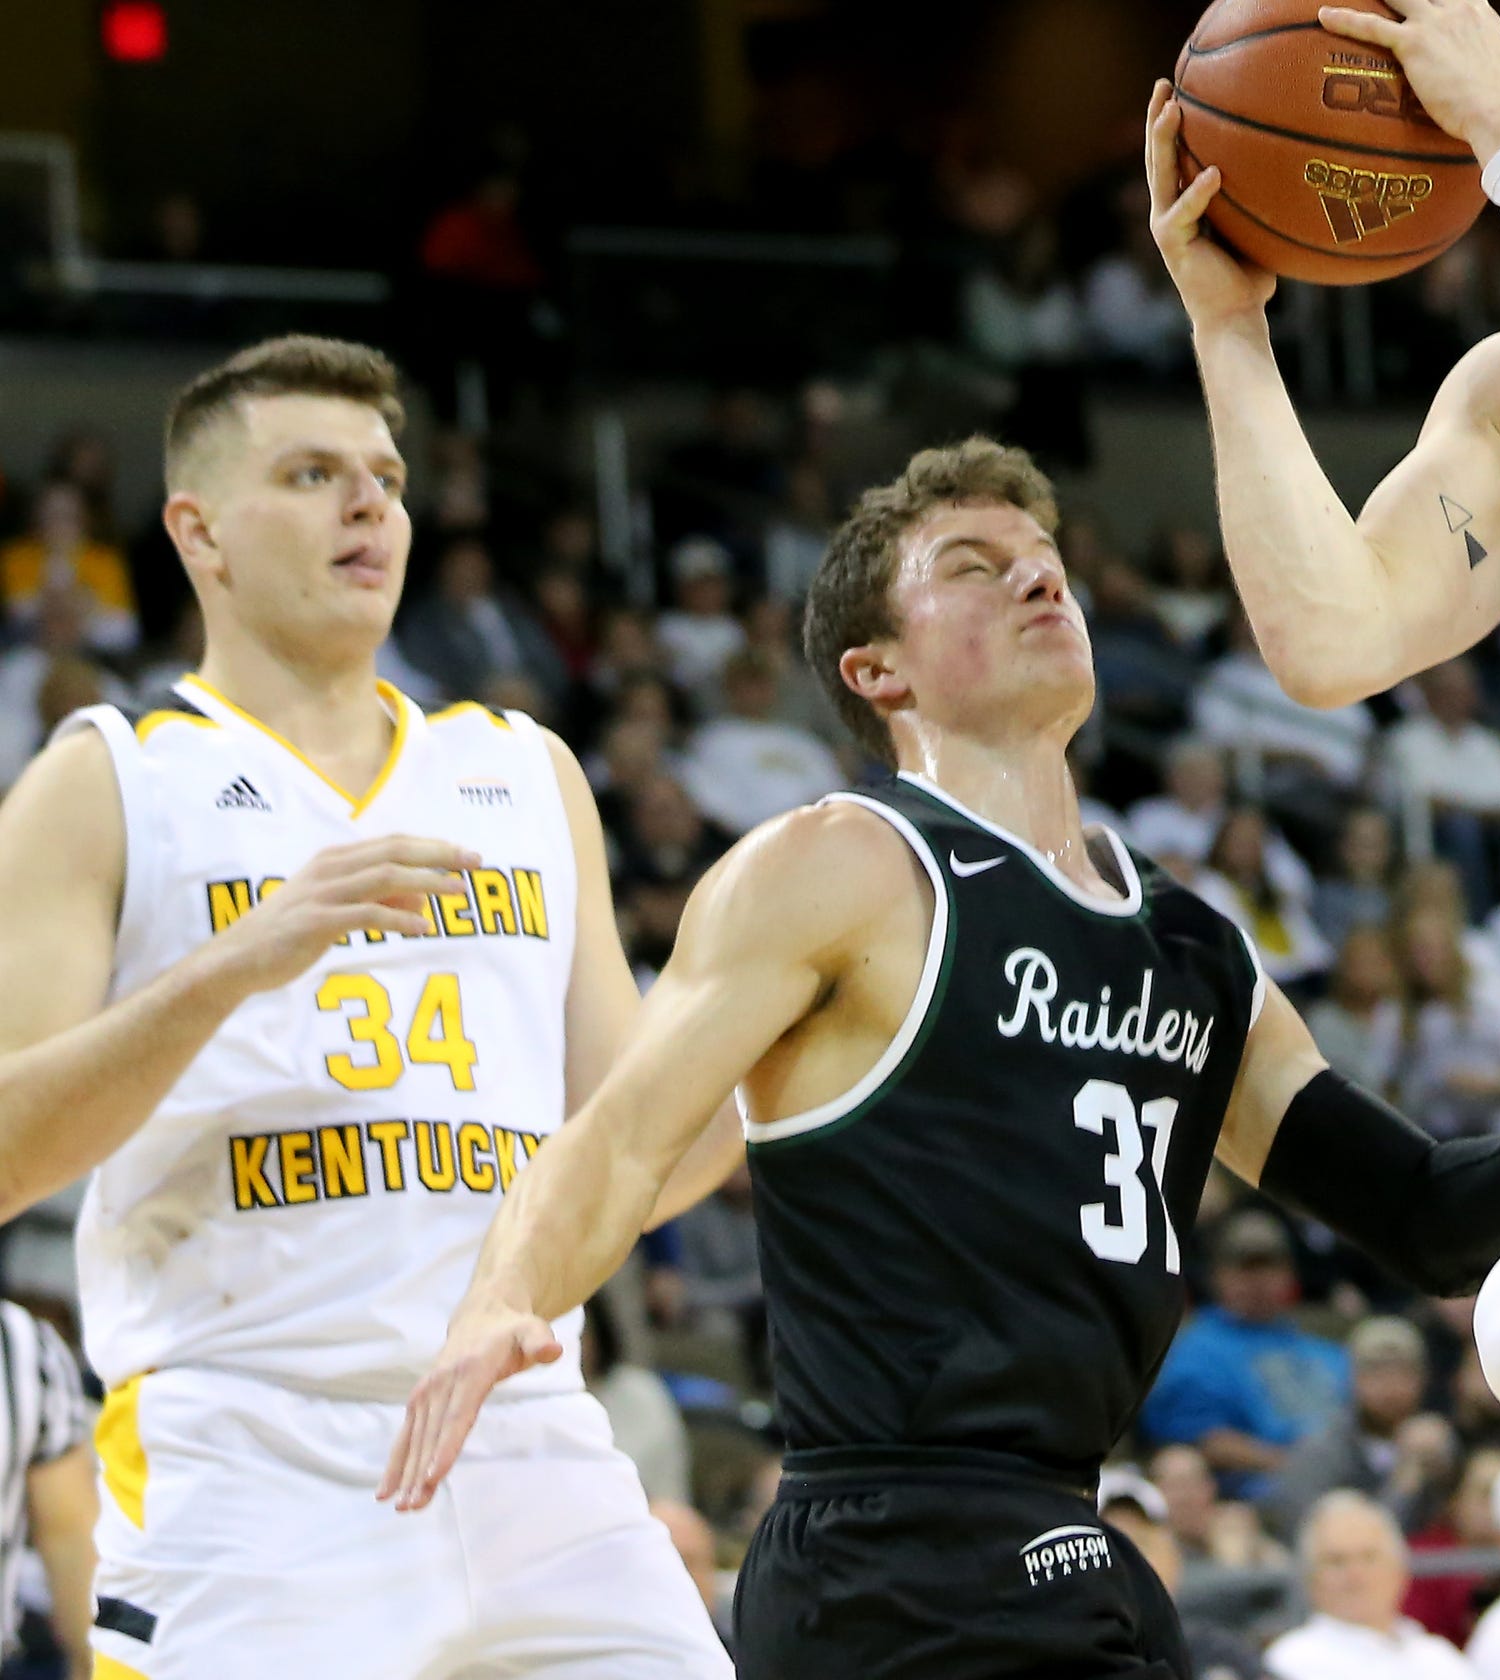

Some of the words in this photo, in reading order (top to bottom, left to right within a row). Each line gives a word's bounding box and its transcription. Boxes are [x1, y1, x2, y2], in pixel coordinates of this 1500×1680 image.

[1304, 159, 1433, 205] adidas
[315, 972, 479, 1091] 34
[998, 947, 1214, 1075] Raiders
[1073, 1078, 1180, 1276] 31
[1024, 1535, 1108, 1573] HORIZON
